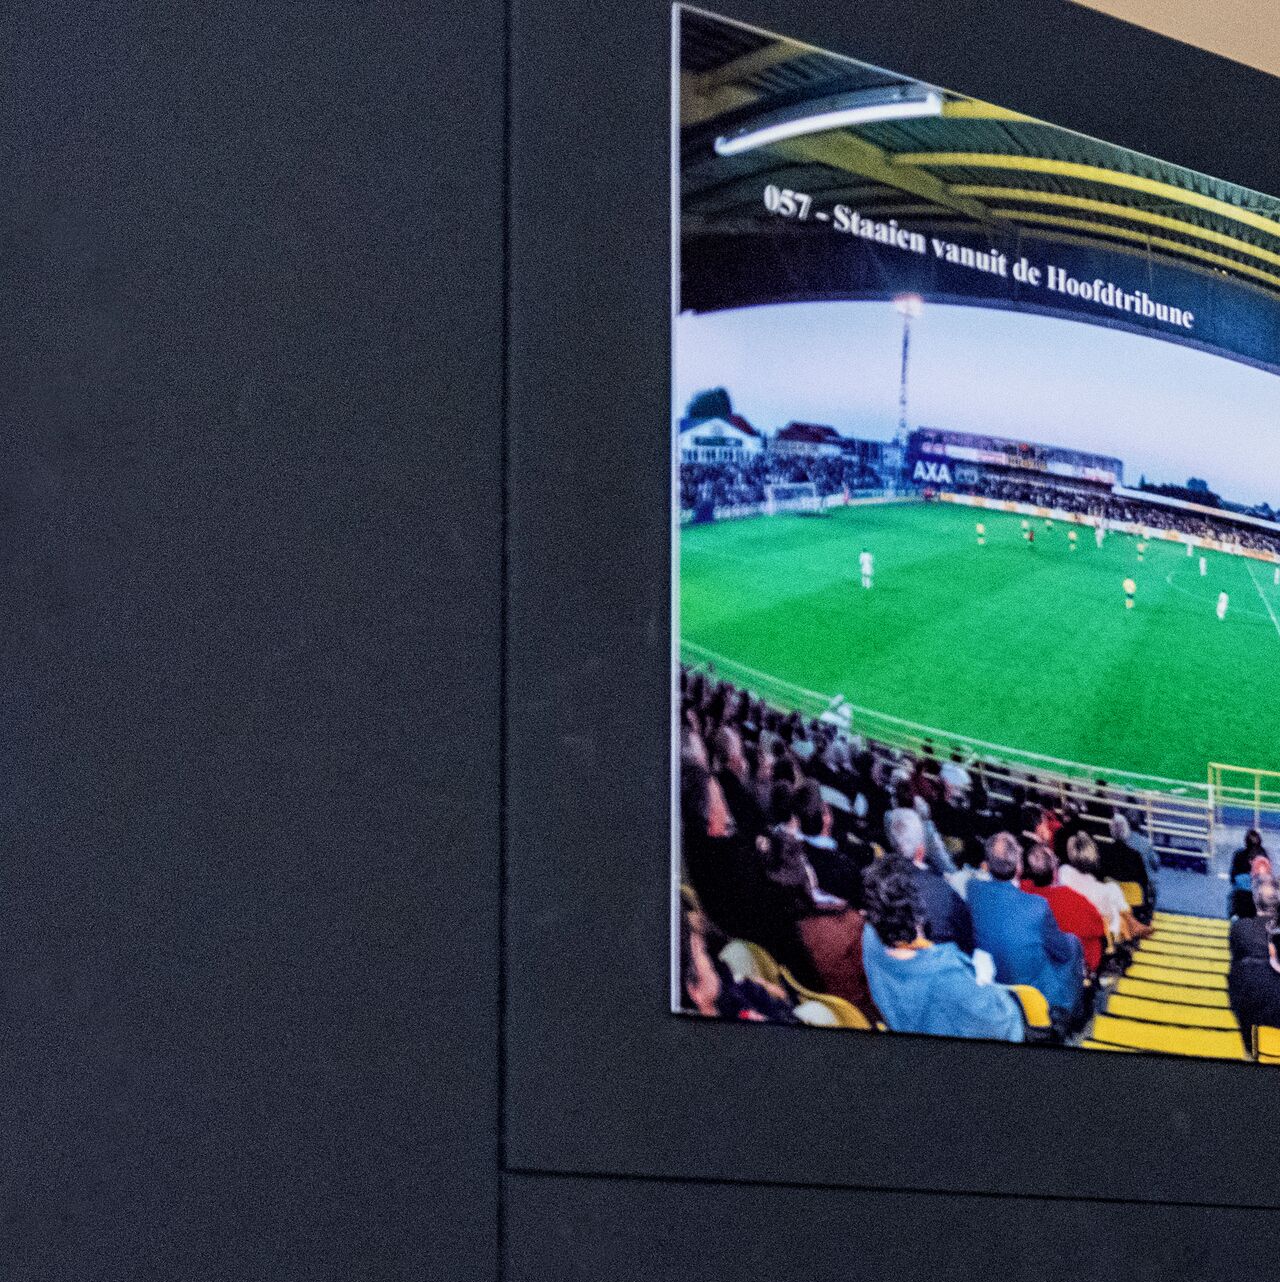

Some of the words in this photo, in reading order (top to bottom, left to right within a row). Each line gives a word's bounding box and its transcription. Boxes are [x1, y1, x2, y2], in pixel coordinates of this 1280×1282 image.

[764, 184, 813, 221] 057
[833, 203, 926, 255] Staaien
[931, 238, 1008, 279] vanuit
[1012, 257, 1042, 286] de
[1047, 264, 1195, 329] Hoofdtribune
[913, 460, 953, 483] AXA
